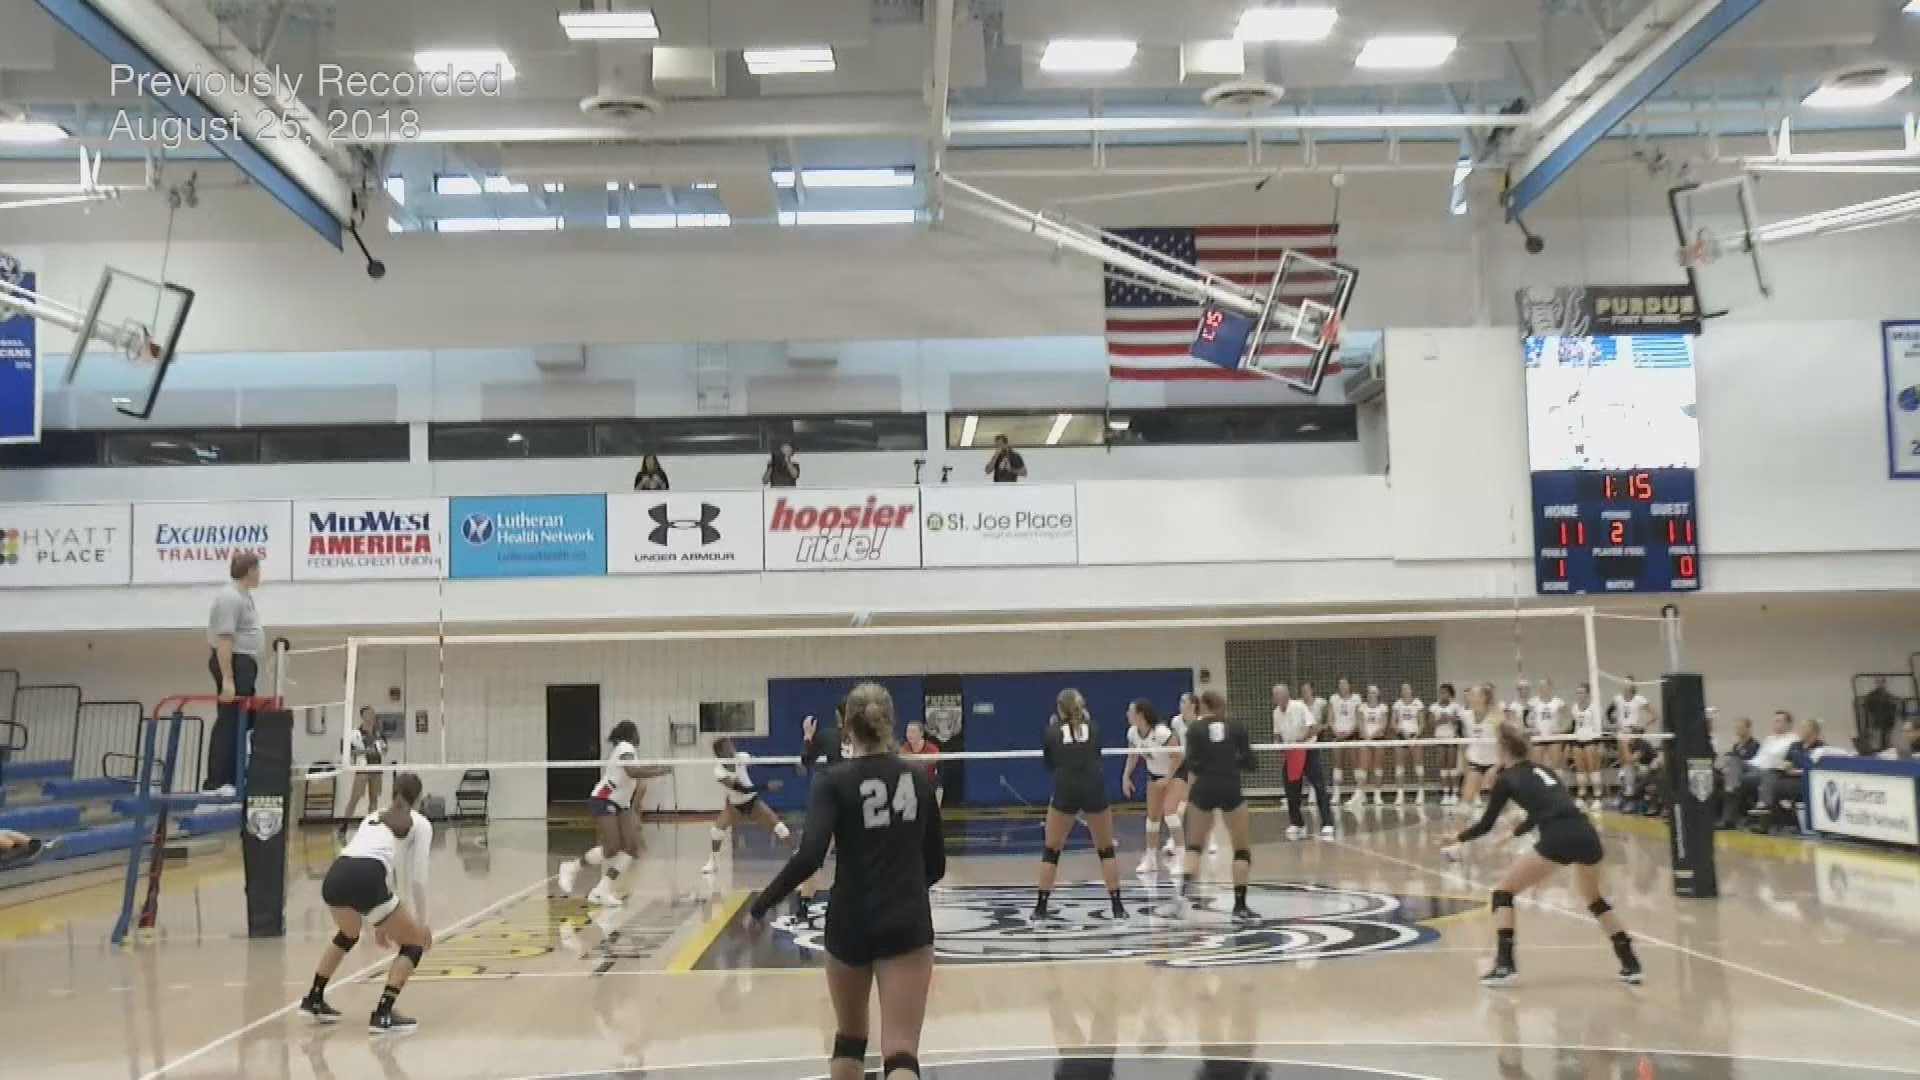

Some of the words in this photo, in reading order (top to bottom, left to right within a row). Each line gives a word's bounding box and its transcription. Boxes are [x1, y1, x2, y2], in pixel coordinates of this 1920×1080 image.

[1595, 296, 1695, 315] PURDUE
[1605, 473, 1652, 499] 1:15
[769, 495, 914, 532] hoosier
[1543, 504, 1579, 518] HOME
[1650, 502, 1690, 516] GUEST
[496, 512, 564, 528] Lutheran
[947, 512, 969, 531] St.
[972, 512, 1011, 531] Joe
[1015, 511, 1073, 529] Place
[23, 528, 117, 546] HYATT
[155, 523, 270, 545] EXCURSIONS
[497, 529, 539, 544] Health
[540, 528, 595, 543] Network
[1560, 522, 1585, 545] 11
[1611, 521, 1624, 543] 2
[1668, 519, 1694, 544] 11
[308, 535, 431, 554] AMERICA
[796, 524, 888, 563] ride!
[37, 550, 105, 563] PLACE
[634, 553, 677, 562] UNDER
[680, 552, 735, 561] ARMOUR
[1680, 554, 1694, 578] 0
[1558, 559, 1566, 577] 1
[859, 772, 918, 829] 24
